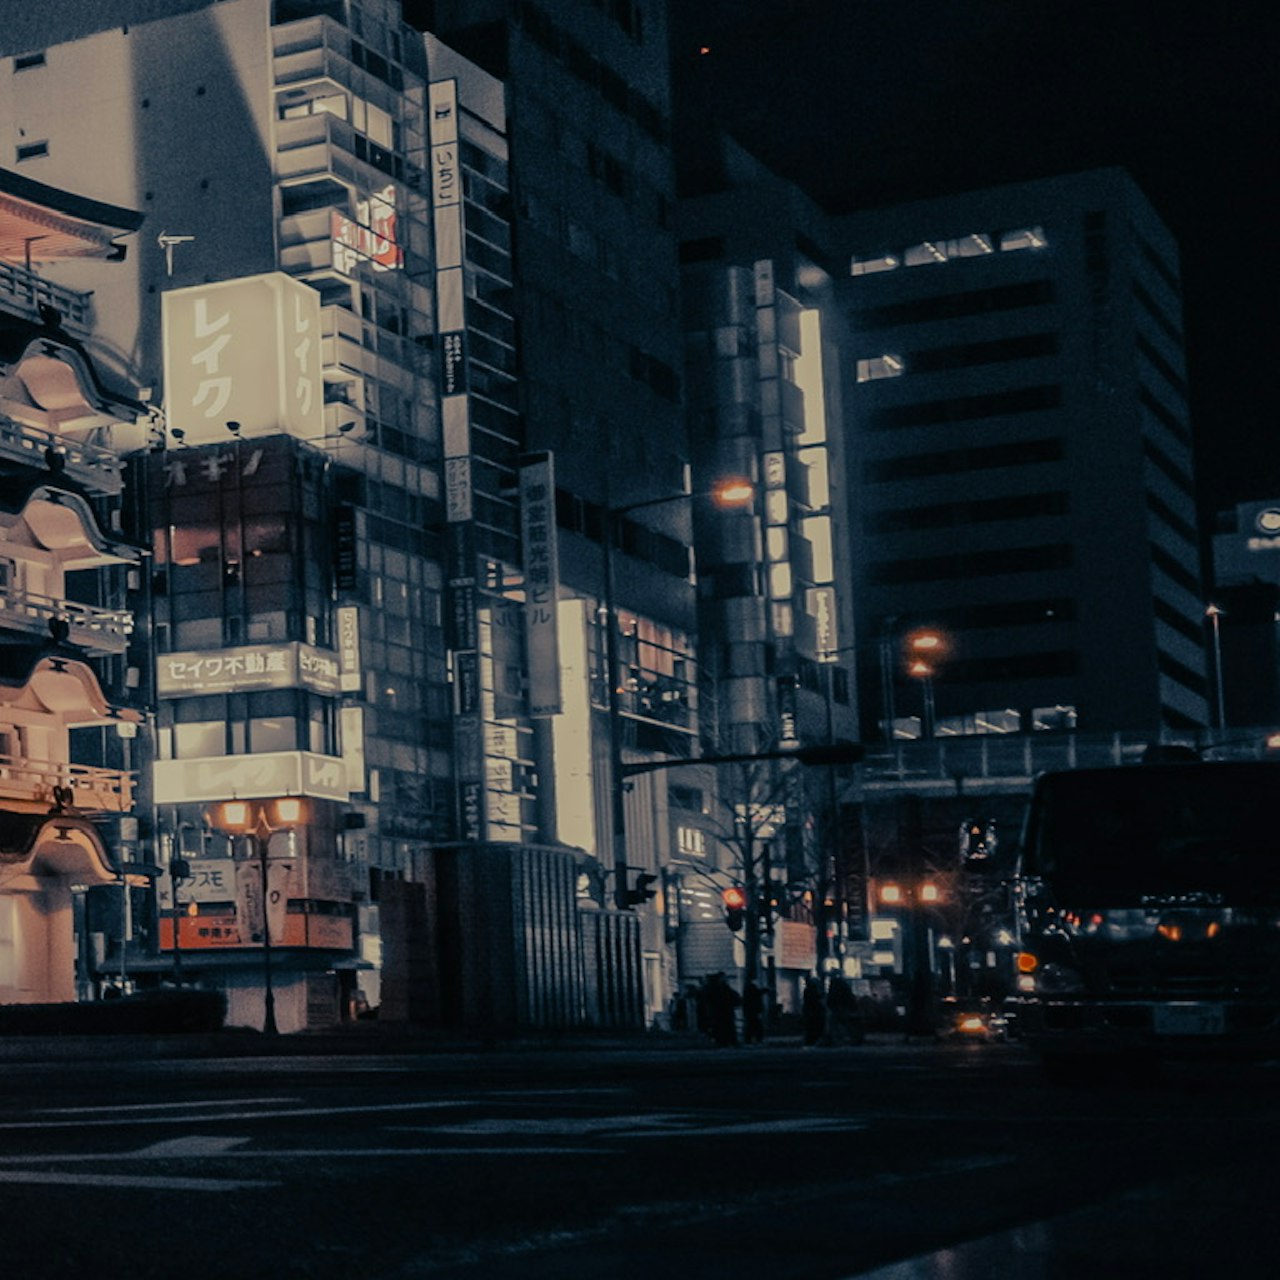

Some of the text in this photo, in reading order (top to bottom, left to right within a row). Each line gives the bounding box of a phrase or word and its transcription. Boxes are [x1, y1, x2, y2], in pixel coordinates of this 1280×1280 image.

[437, 150, 454, 200] いちご
[191, 297, 233, 419] レイク
[294, 294, 313, 416] レイク
[168, 651, 288, 680] セイワ不動産
[198, 759, 277, 790] レイク
